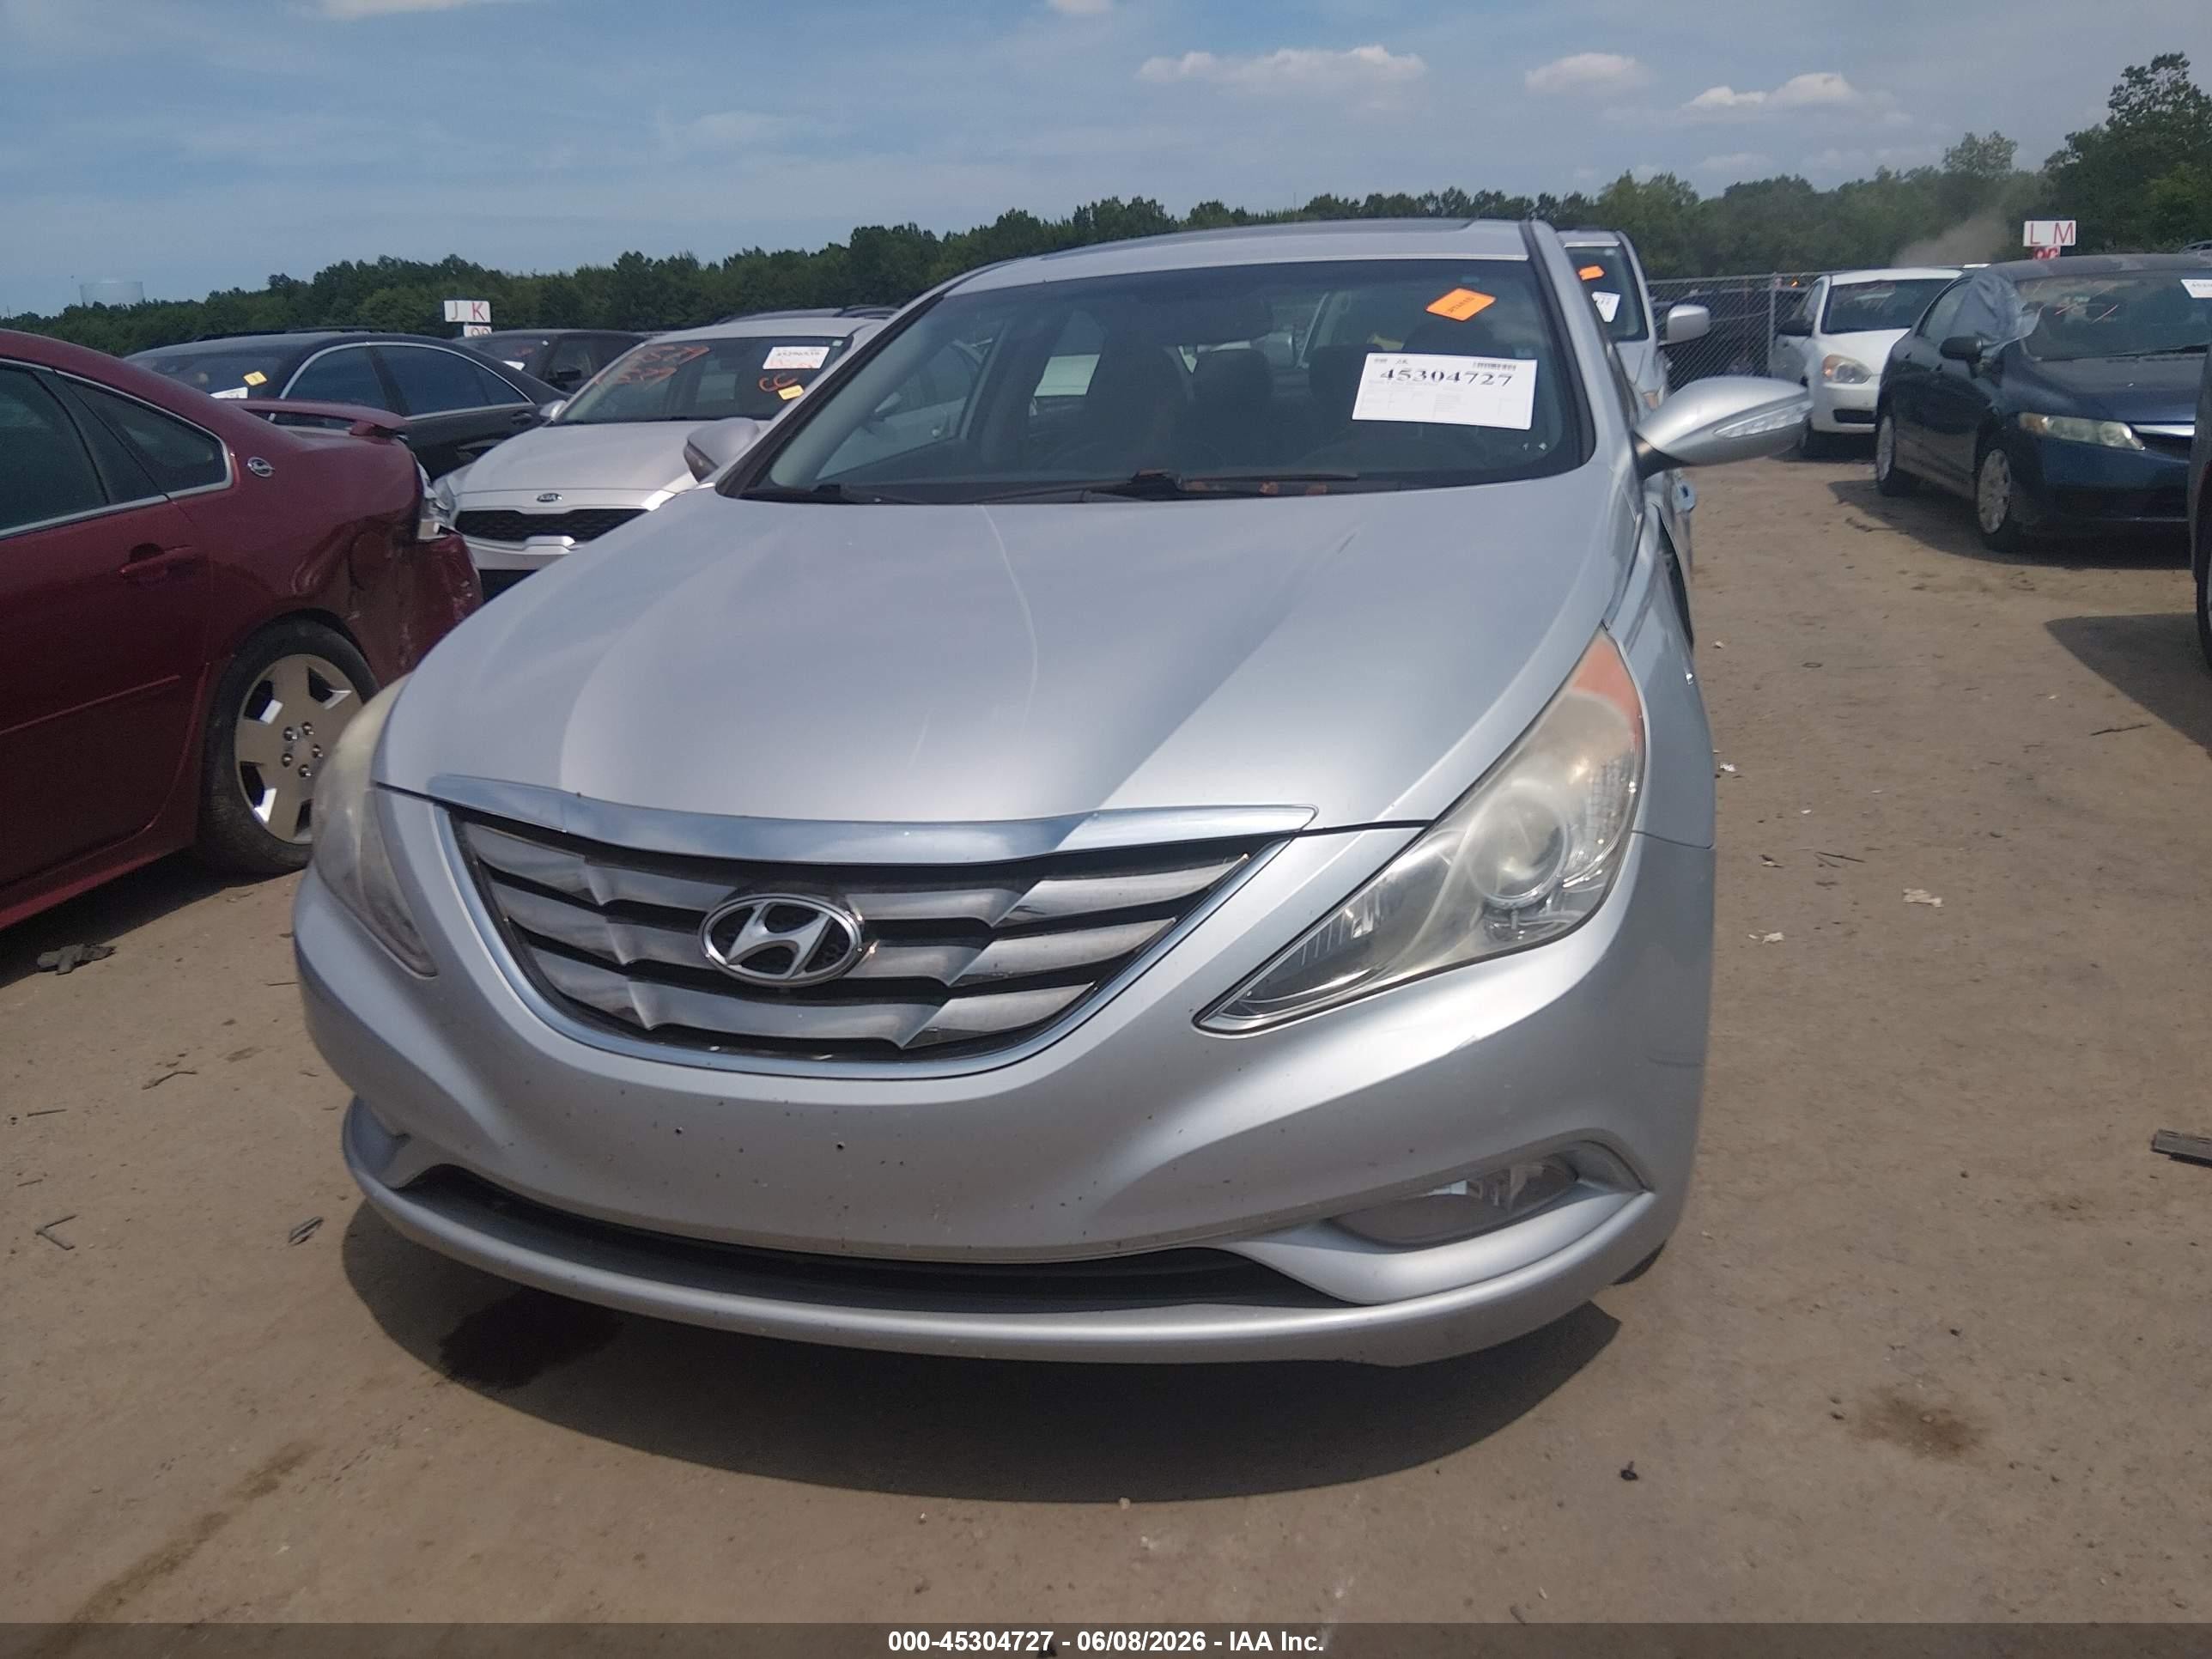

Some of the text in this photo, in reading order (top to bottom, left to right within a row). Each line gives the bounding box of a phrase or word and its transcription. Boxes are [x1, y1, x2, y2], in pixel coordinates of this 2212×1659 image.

[2030, 222, 2074, 245] L M
[451, 301, 486, 321] J K
[1379, 368, 1513, 386] 45304727
